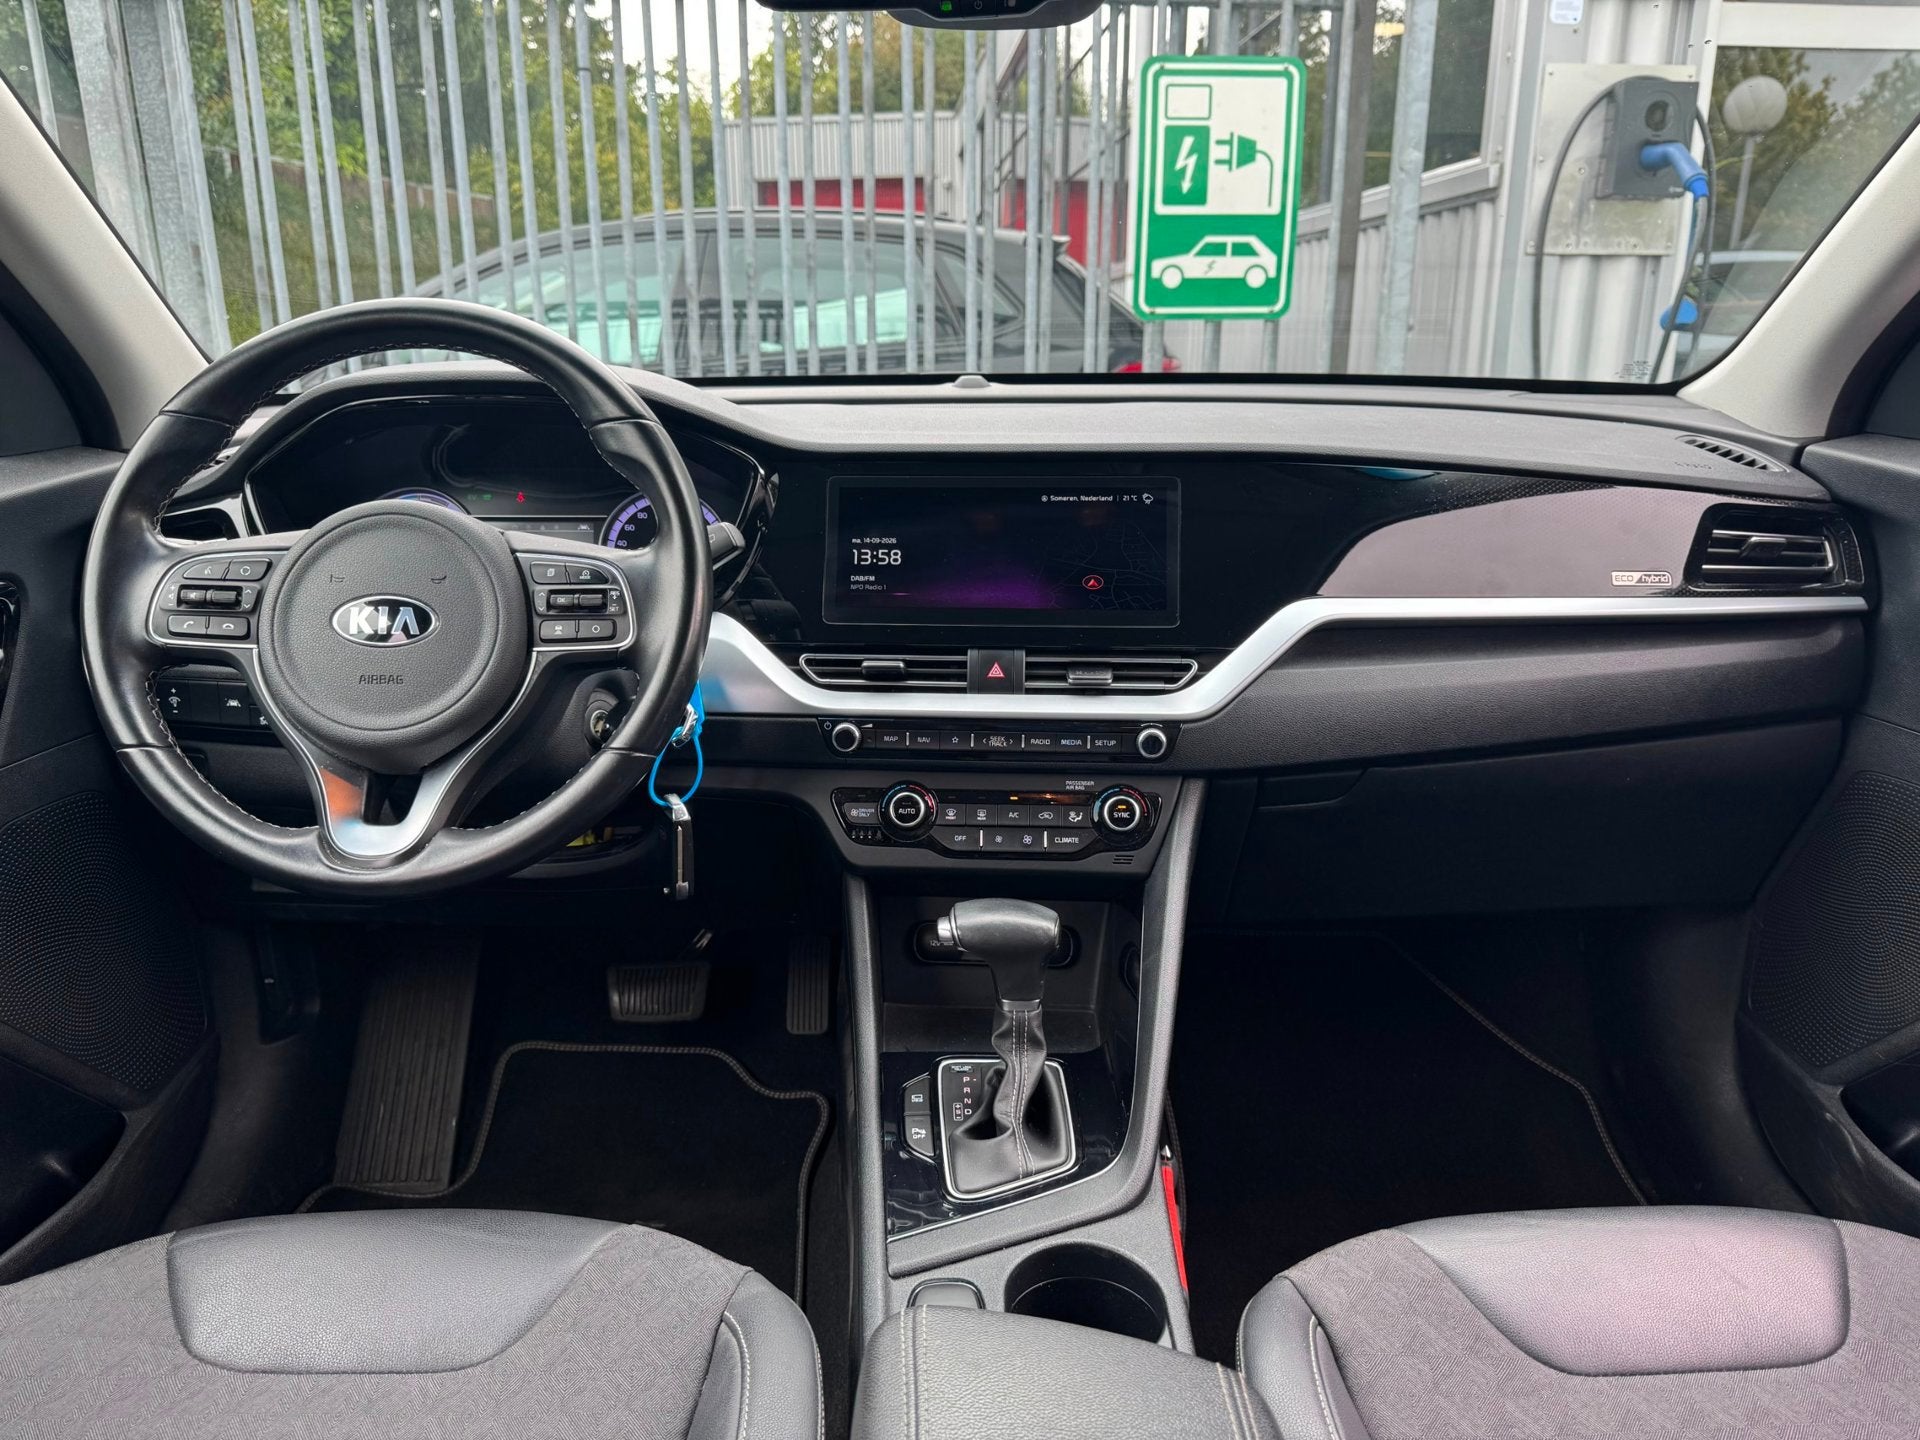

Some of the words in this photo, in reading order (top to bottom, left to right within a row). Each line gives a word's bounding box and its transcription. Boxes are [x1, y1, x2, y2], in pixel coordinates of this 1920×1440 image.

[637, 511, 648, 519] 80
[852, 549, 902, 566] 13:58
[1614, 574, 1634, 582] ECO
[1641, 573, 1669, 584] hybrid
[349, 606, 420, 635] KIA
[358, 674, 404, 685] AIRBAG
